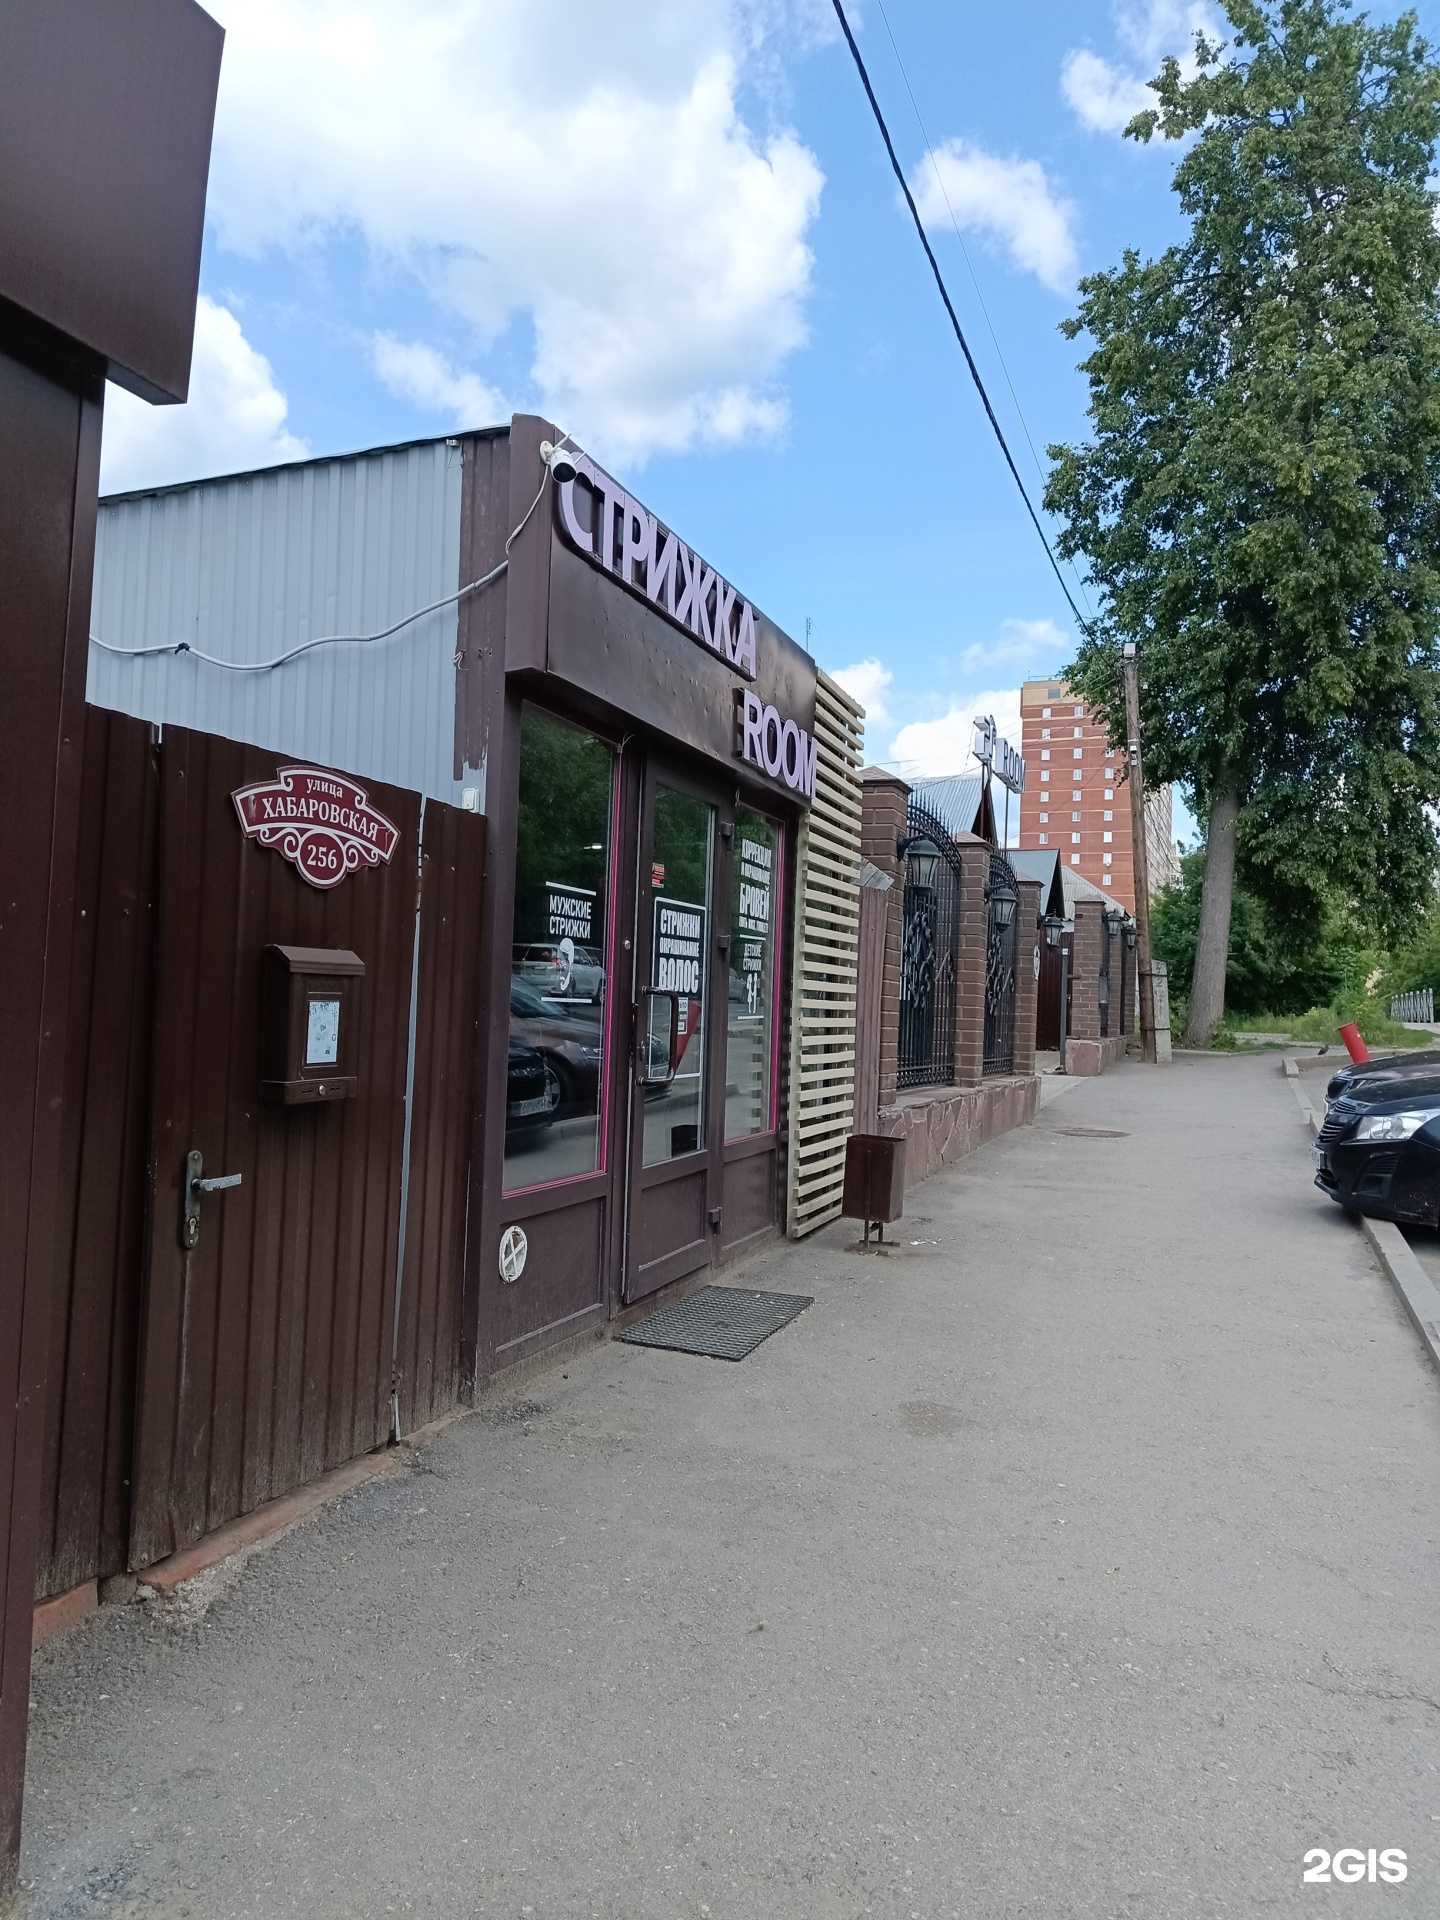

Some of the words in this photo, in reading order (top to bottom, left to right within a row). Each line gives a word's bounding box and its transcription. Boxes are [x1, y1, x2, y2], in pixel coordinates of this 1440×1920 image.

[559, 452, 758, 682] СТРИЖКА
[743, 688, 817, 800] ROOM
[306, 777, 344, 798] улица
[262, 797, 379, 842] ХАБАРОВСКАЯ
[306, 844, 337, 869] 256
[549, 894, 592, 920] МУЖСКИЕ
[739, 882, 770, 921] БРОВЕЙ
[549, 915, 591, 939] СТРИЖКИ
[660, 908, 701, 939] СТРИЖКИ
[658, 957, 700, 994] ВОЛОС
